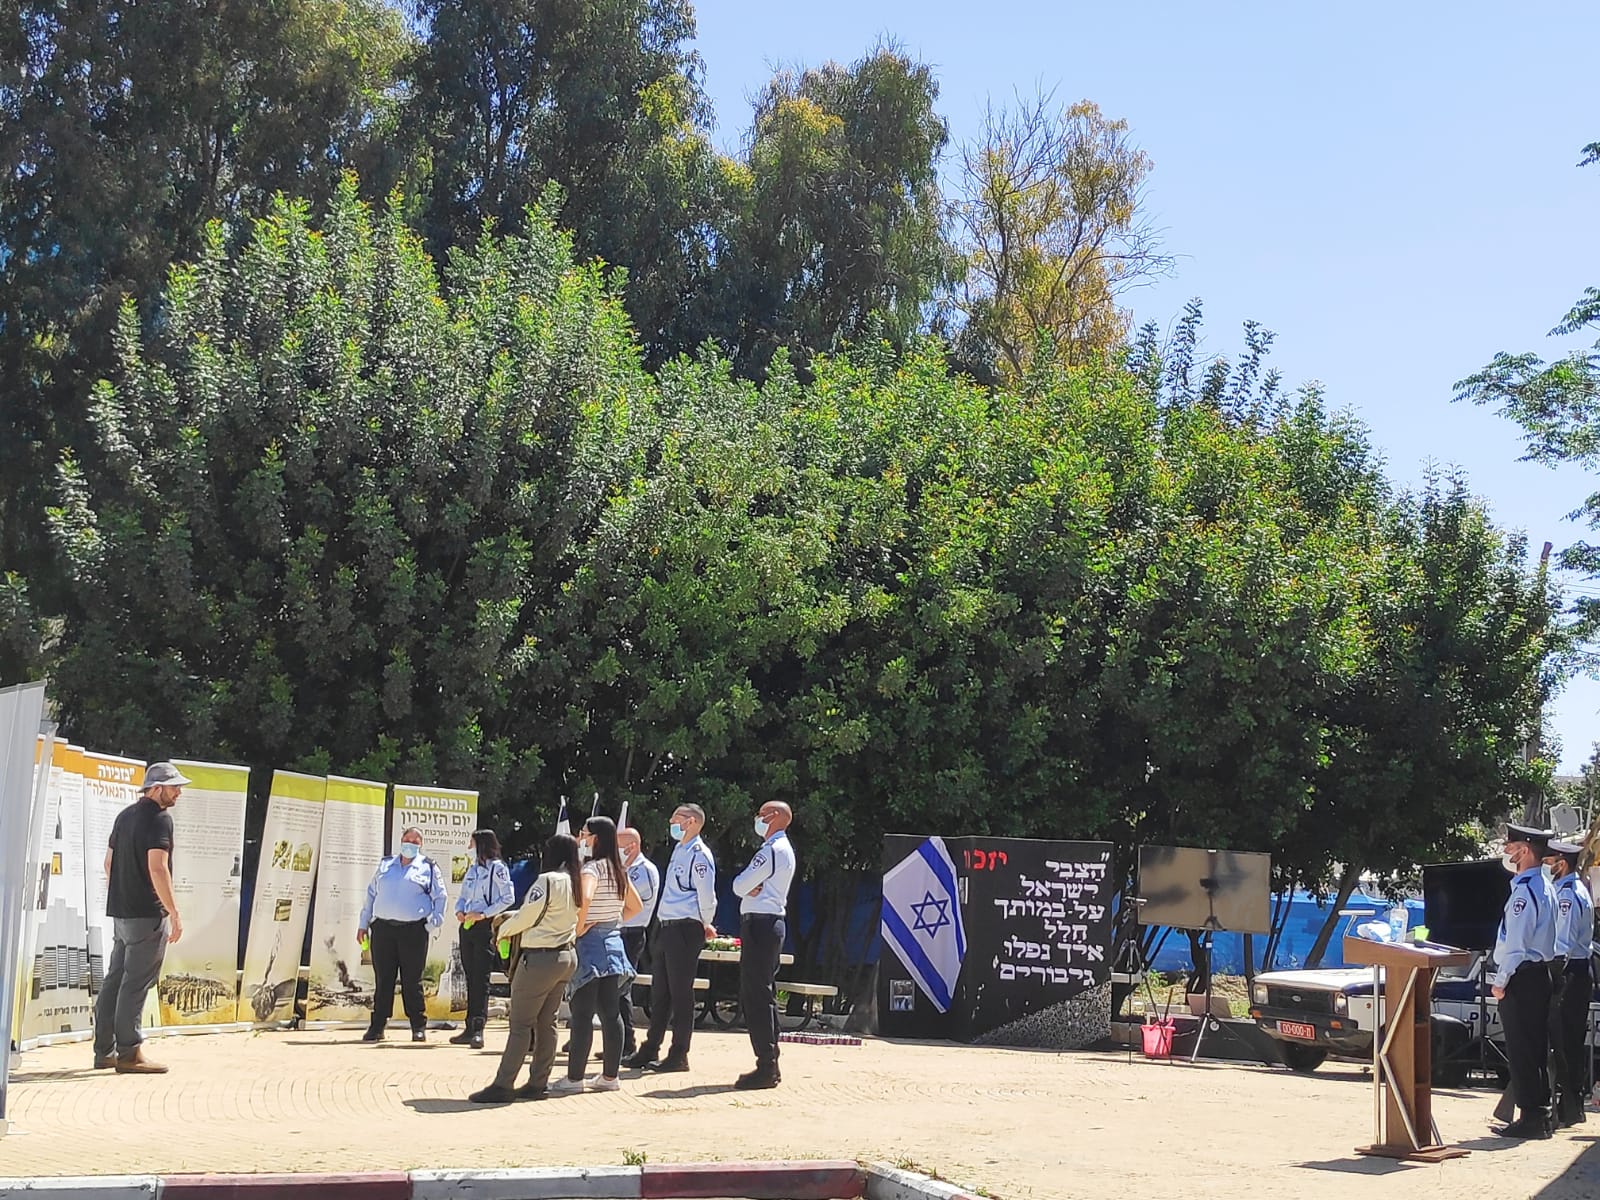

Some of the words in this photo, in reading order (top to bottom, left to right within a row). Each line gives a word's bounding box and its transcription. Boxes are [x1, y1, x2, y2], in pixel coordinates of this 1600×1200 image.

[404, 794, 468, 811] התפתחות
[401, 811, 448, 825] הזיכרון
[452, 814, 471, 826] יום
